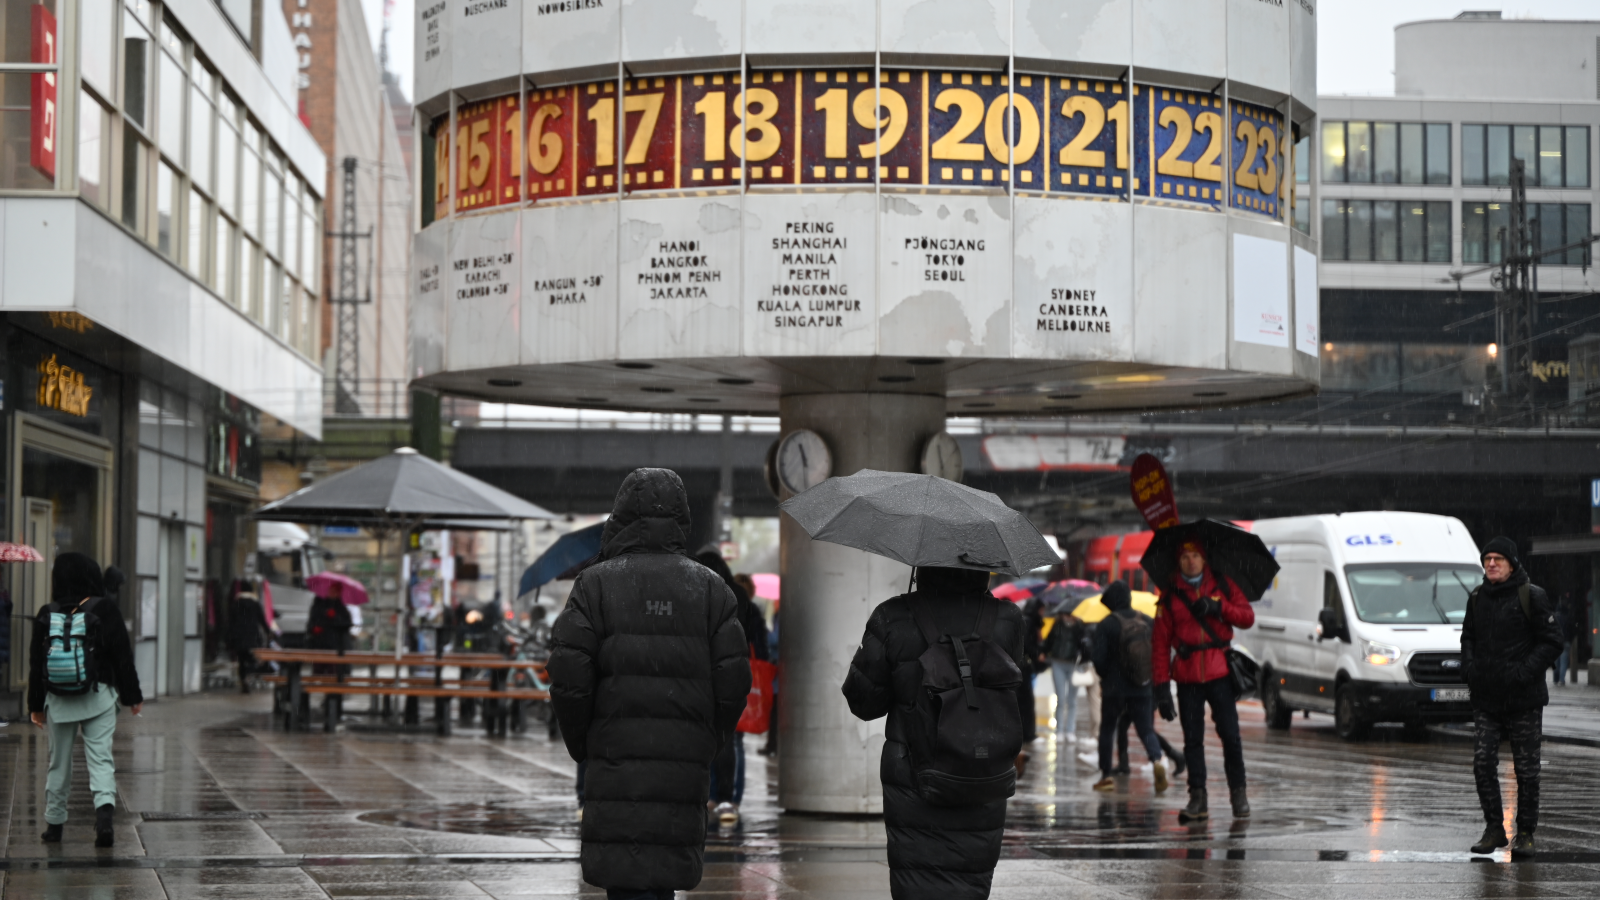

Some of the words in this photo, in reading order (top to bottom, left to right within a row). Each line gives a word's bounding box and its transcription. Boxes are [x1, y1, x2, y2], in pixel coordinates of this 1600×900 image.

[456, 118, 491, 191] 15
[505, 103, 563, 178] 16
[587, 92, 665, 167] 17
[694, 87, 782, 162] 18
[814, 87, 909, 159] 19
[931, 88, 1041, 165] 20
[1059, 95, 1129, 169] 21
[1157, 105, 1223, 182] 22
[1234, 119, 1277, 195] 23
[785, 222, 834, 234] PEKING
[659, 240, 700, 253] HANOI
[772, 237, 847, 250] SHANGHAI
[904, 236, 985, 252] PJÖNGJANG
[454, 258, 469, 271] NEW
[473, 255, 495, 269] DELHI
[650, 255, 708, 269] BANGKOK
[782, 253, 837, 265] MANILA
[925, 254, 965, 266] TOKYO
[465, 269, 501, 285] KARACHI
[638, 272, 682, 285] PHNOM
[688, 270, 721, 283] PENH
[788, 268, 830, 281] PERTH
[924, 269, 966, 282] SEOUL
[534, 277, 577, 292] RANGUN
[772, 284, 848, 297] HONGKONG
[457, 286, 491, 300] COLOMBO
[549, 293, 587, 306] DHAKA
[650, 286, 709, 300] JAKARTA
[1051, 288, 1096, 301] SYDNEY
[757, 300, 802, 313] KUALA
[808, 299, 862, 312] LUMPUR
[1039, 303, 1108, 317] CANBERRA
[774, 315, 843, 328] SINGAPUR
[1036, 319, 1111, 333] MELBOURNE
